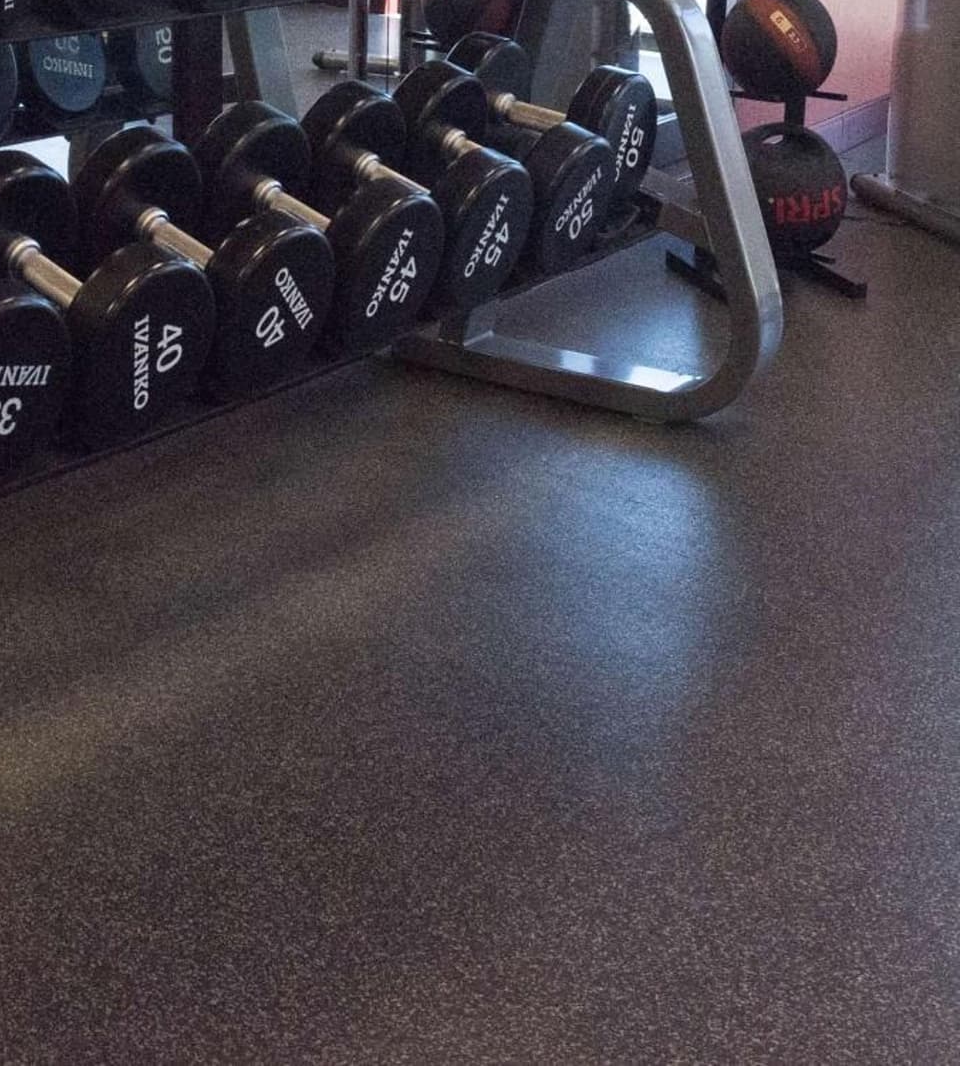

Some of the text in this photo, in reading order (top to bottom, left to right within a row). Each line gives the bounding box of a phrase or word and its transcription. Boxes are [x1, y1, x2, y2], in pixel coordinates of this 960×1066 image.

[625, 126, 645, 168] 50
[555, 166, 603, 232] IVANKO
[568, 198, 593, 240] 50
[463, 193, 509, 279] IVANKO
[483, 221, 510, 269] 45
[365, 228, 414, 318] IVANKO
[389, 256, 418, 304] 45
[275, 267, 314, 330] IVANKO
[155, 323, 182, 373] 40
[255, 305, 284, 348] 40
[134, 315, 149, 410] IVANKO
